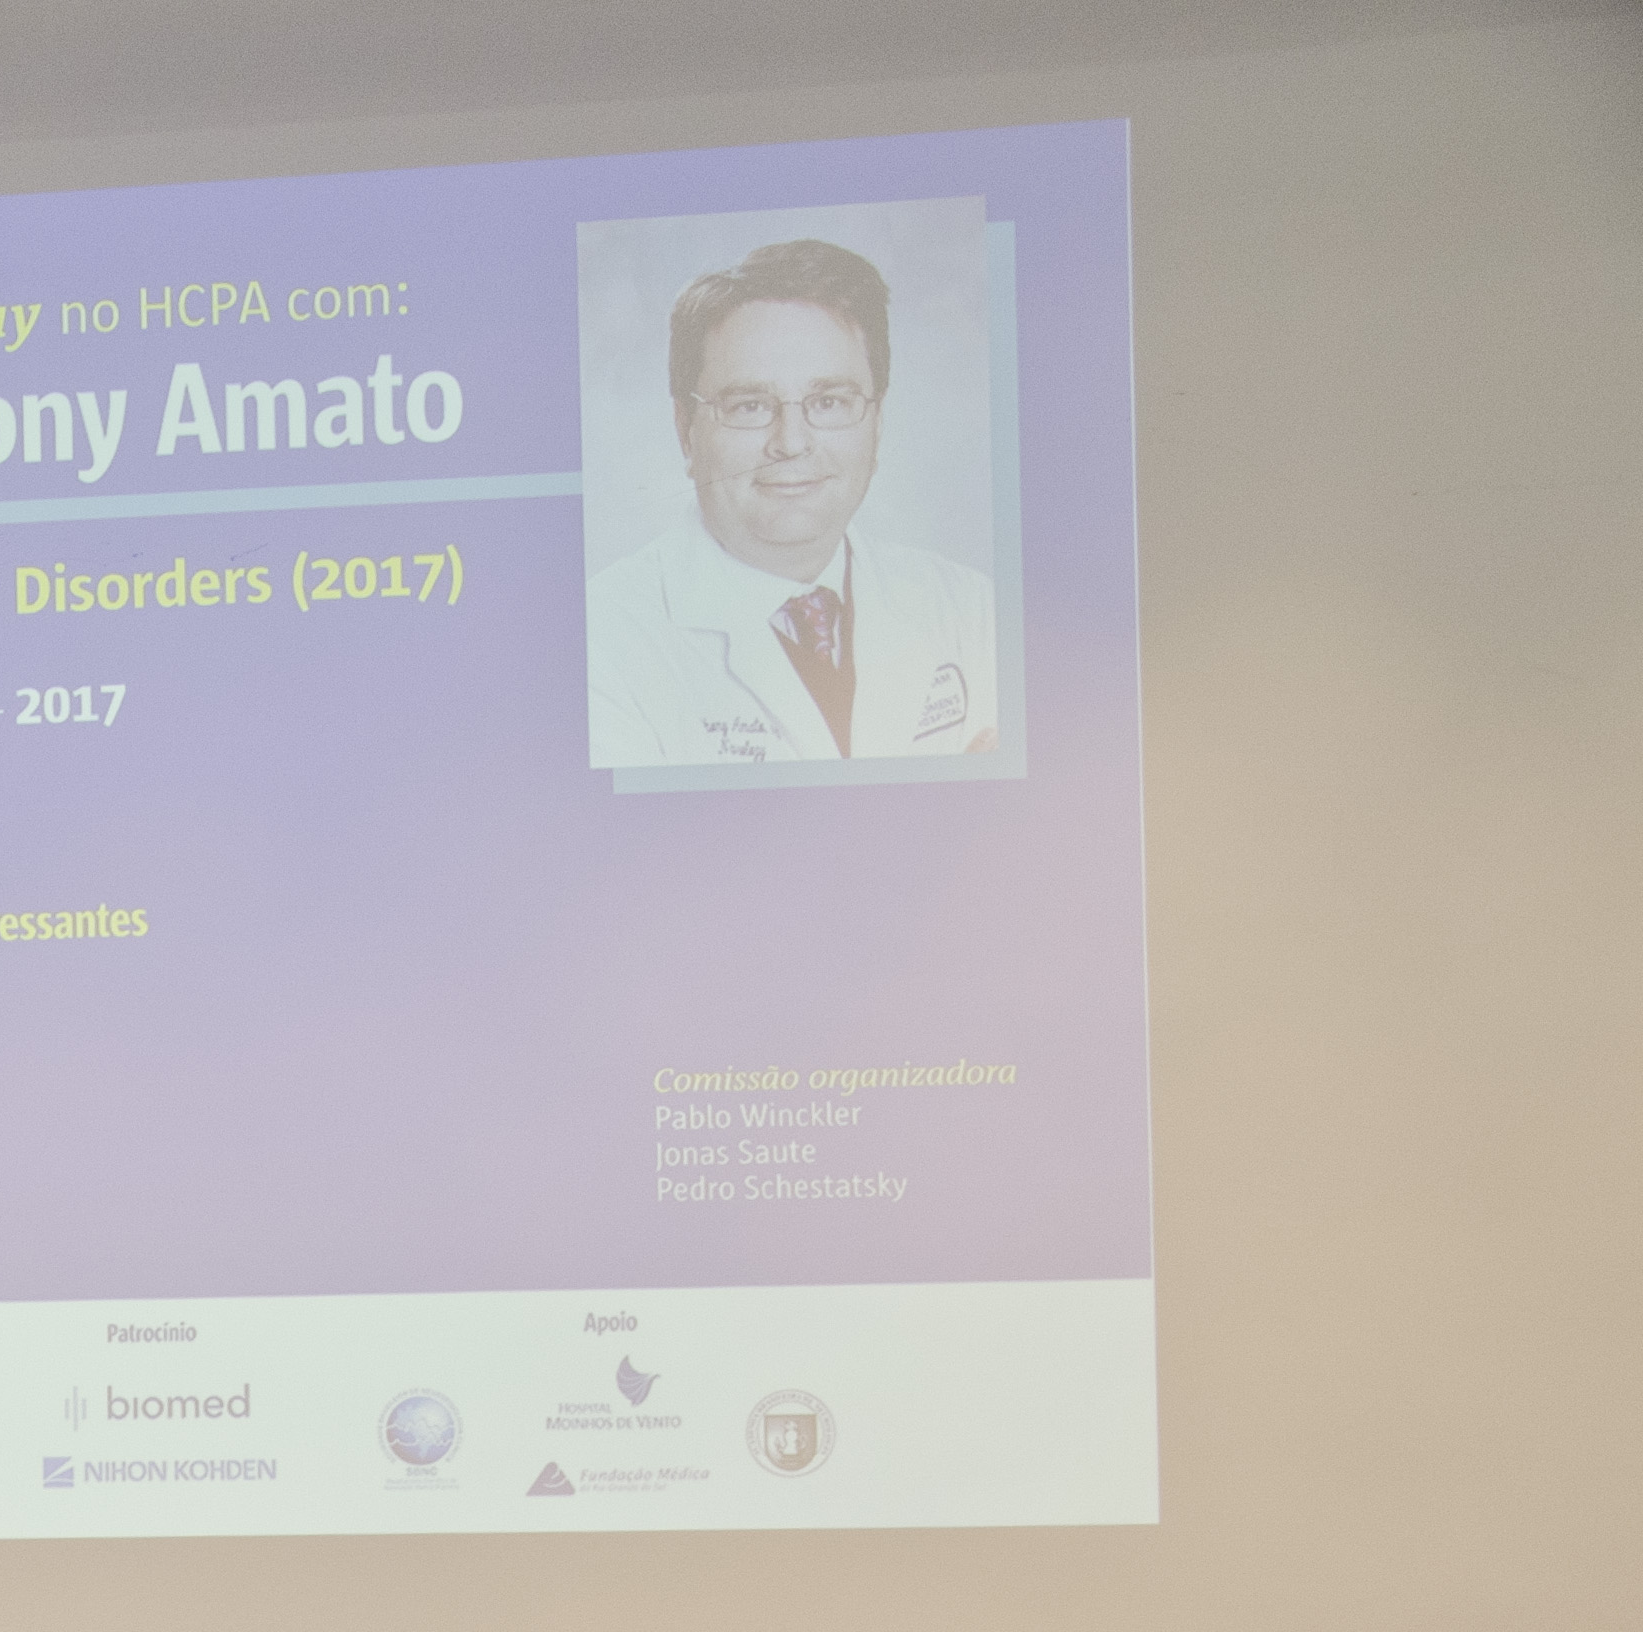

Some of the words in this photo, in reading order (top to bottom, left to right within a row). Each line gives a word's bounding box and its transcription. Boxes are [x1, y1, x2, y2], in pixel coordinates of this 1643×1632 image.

[62, 300, 119, 334] no
[140, 280, 270, 329] HCPA
[288, 282, 408, 321] com:
[157, 355, 463, 455] Amato
[16, 558, 272, 614] Disorders
[293, 545, 463, 611] (2017)
[16, 684, 126, 727] 2017
[653, 1065, 800, 1093] Comissão
[809, 1058, 1017, 1097] organizadora
[656, 1104, 731, 1130] Pablo
[740, 1101, 861, 1128] Winckler
[656, 1142, 729, 1171] Jonas
[738, 1139, 816, 1165] Saute
[657, 1175, 735, 1202] Pedro
[744, 1171, 908, 1202] Schestatsky
[107, 1321, 197, 1343] Patrocínio
[583, 1311, 638, 1336] Apoio
[107, 1383, 250, 1420] biomed
[546, 1416, 612, 1431] MOINHOS
[617, 1416, 634, 1429] DE
[637, 1415, 681, 1429] VENTO
[84, 1461, 167, 1482] NIHON
[174, 1459, 277, 1481] KOHDEN
[580, 1468, 652, 1483] Fundação
[658, 1467, 709, 1481] Médica
